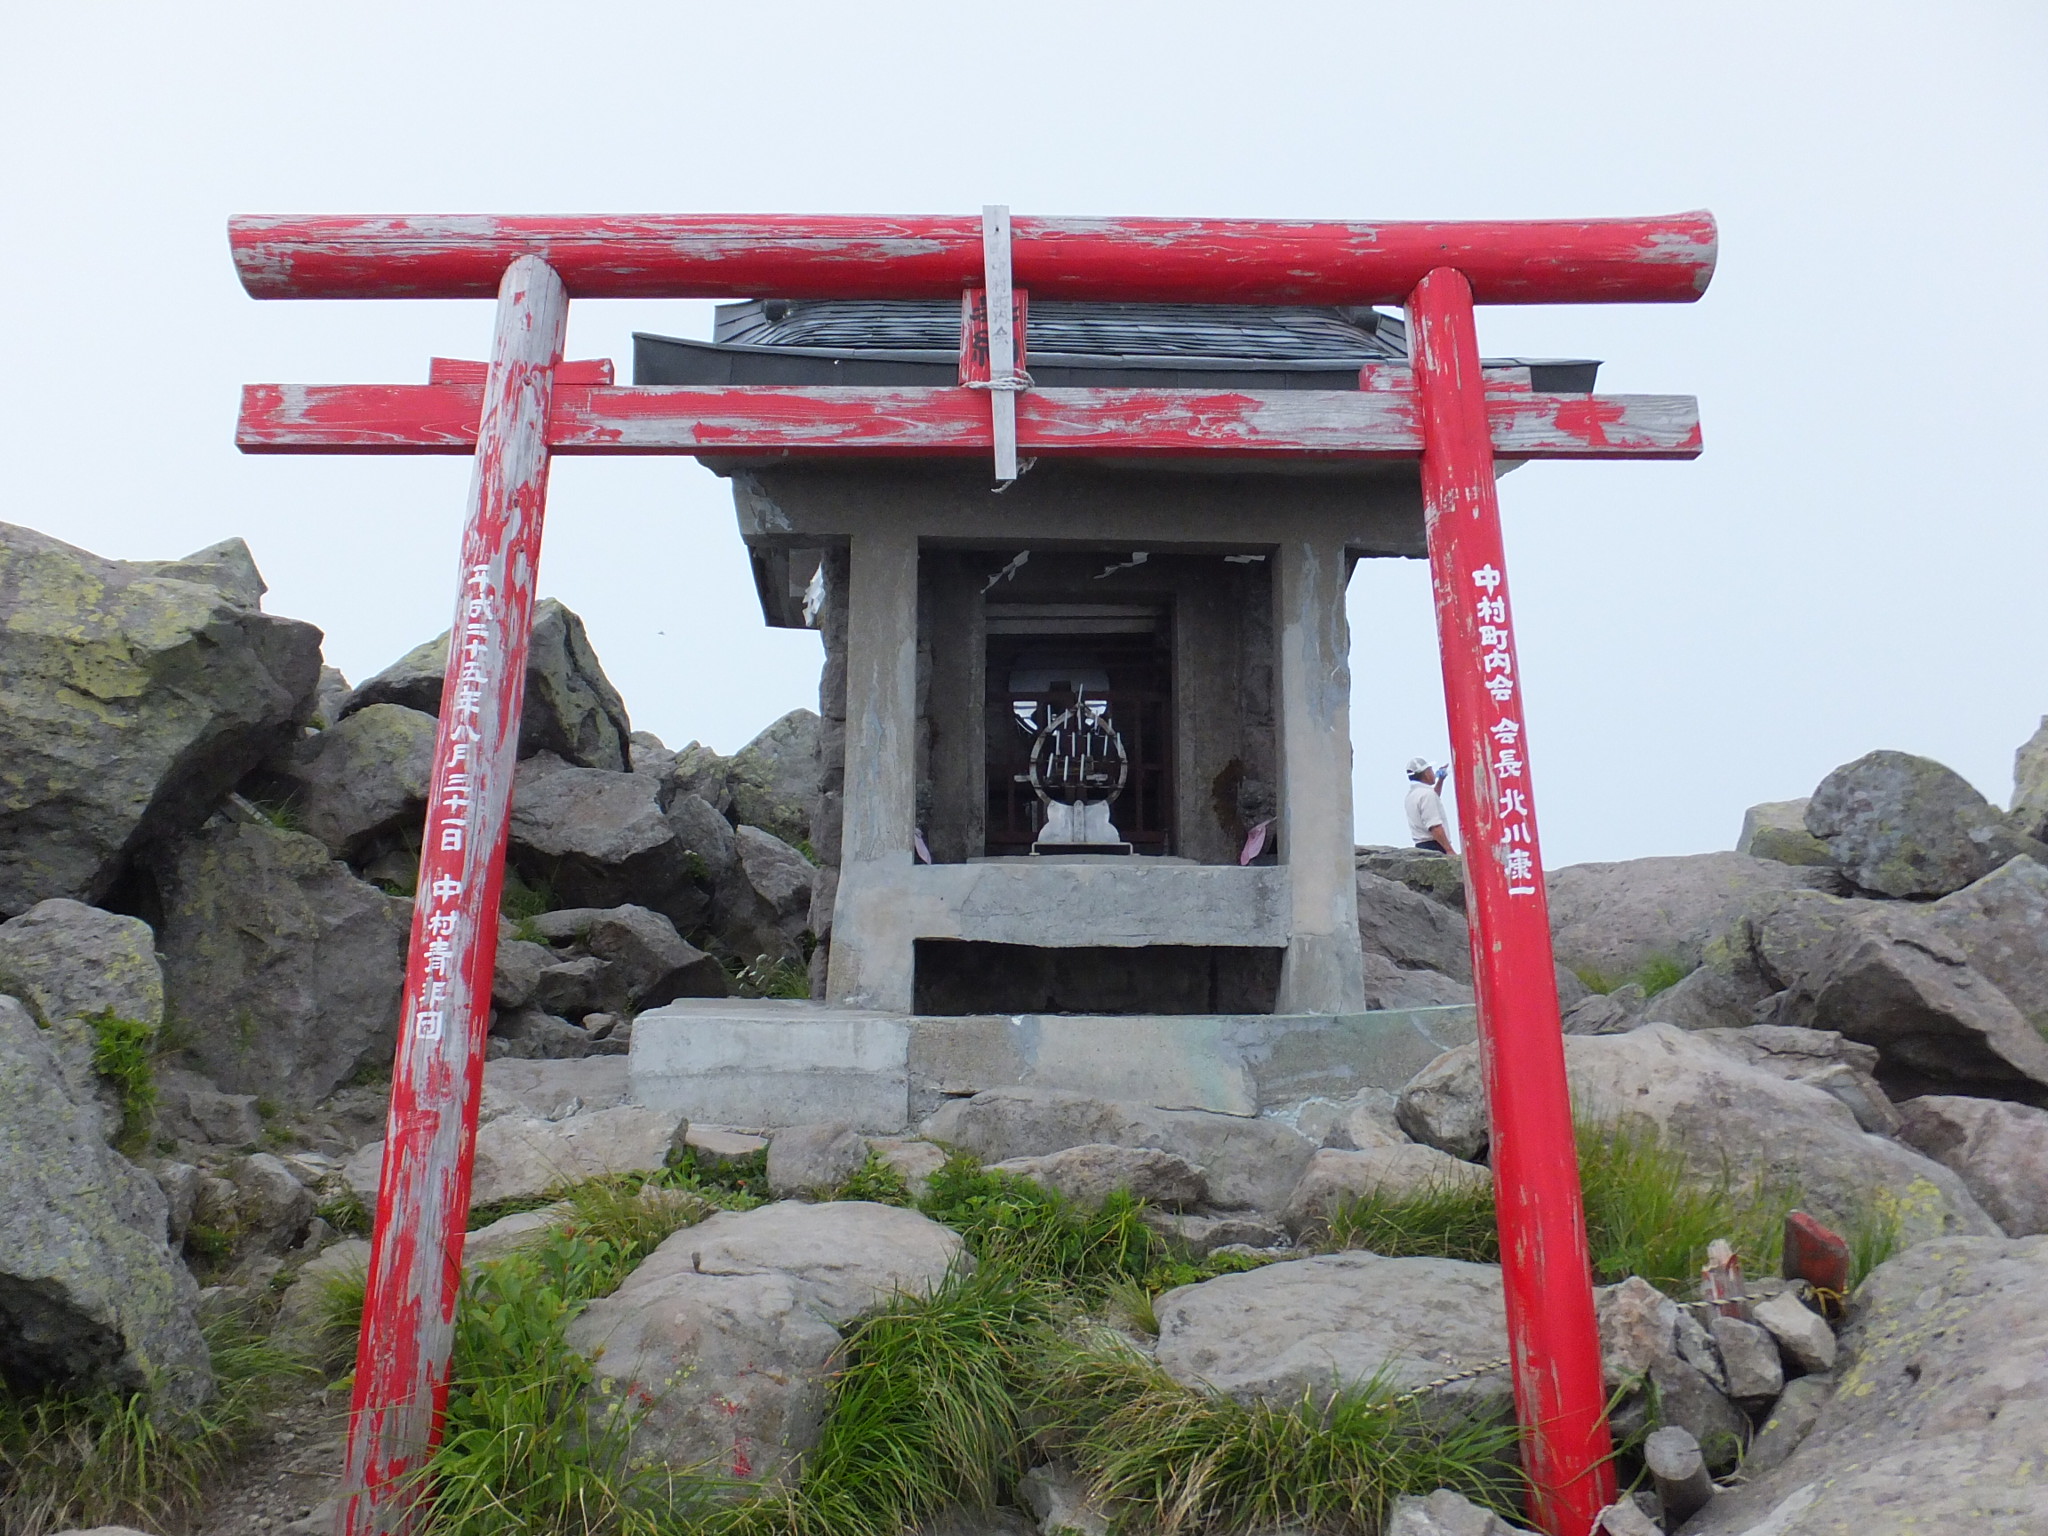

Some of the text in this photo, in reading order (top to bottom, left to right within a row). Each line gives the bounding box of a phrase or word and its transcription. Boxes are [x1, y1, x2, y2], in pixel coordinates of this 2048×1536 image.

[1471, 563, 1536, 896] 中村町内会 会長 北川康一
